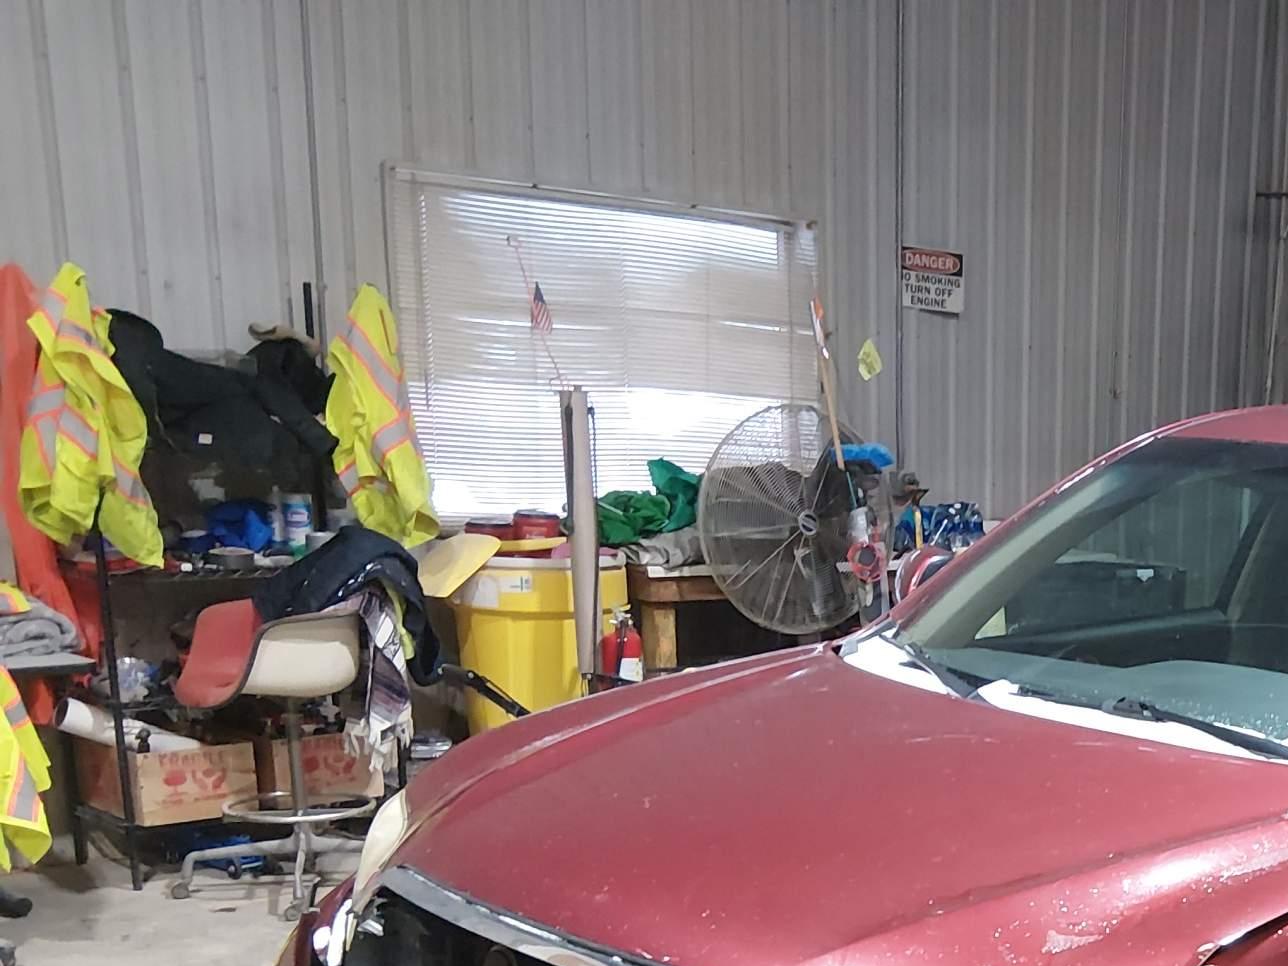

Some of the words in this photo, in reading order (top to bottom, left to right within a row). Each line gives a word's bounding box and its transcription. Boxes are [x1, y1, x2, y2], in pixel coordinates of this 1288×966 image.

[905, 252, 954, 270] DANGER
[904, 272, 911, 281] O
[915, 273, 961, 289] SMOKING
[904, 283, 931, 295] TURN
[934, 287, 954, 298] OFF
[910, 295, 947, 309] ENGINE
